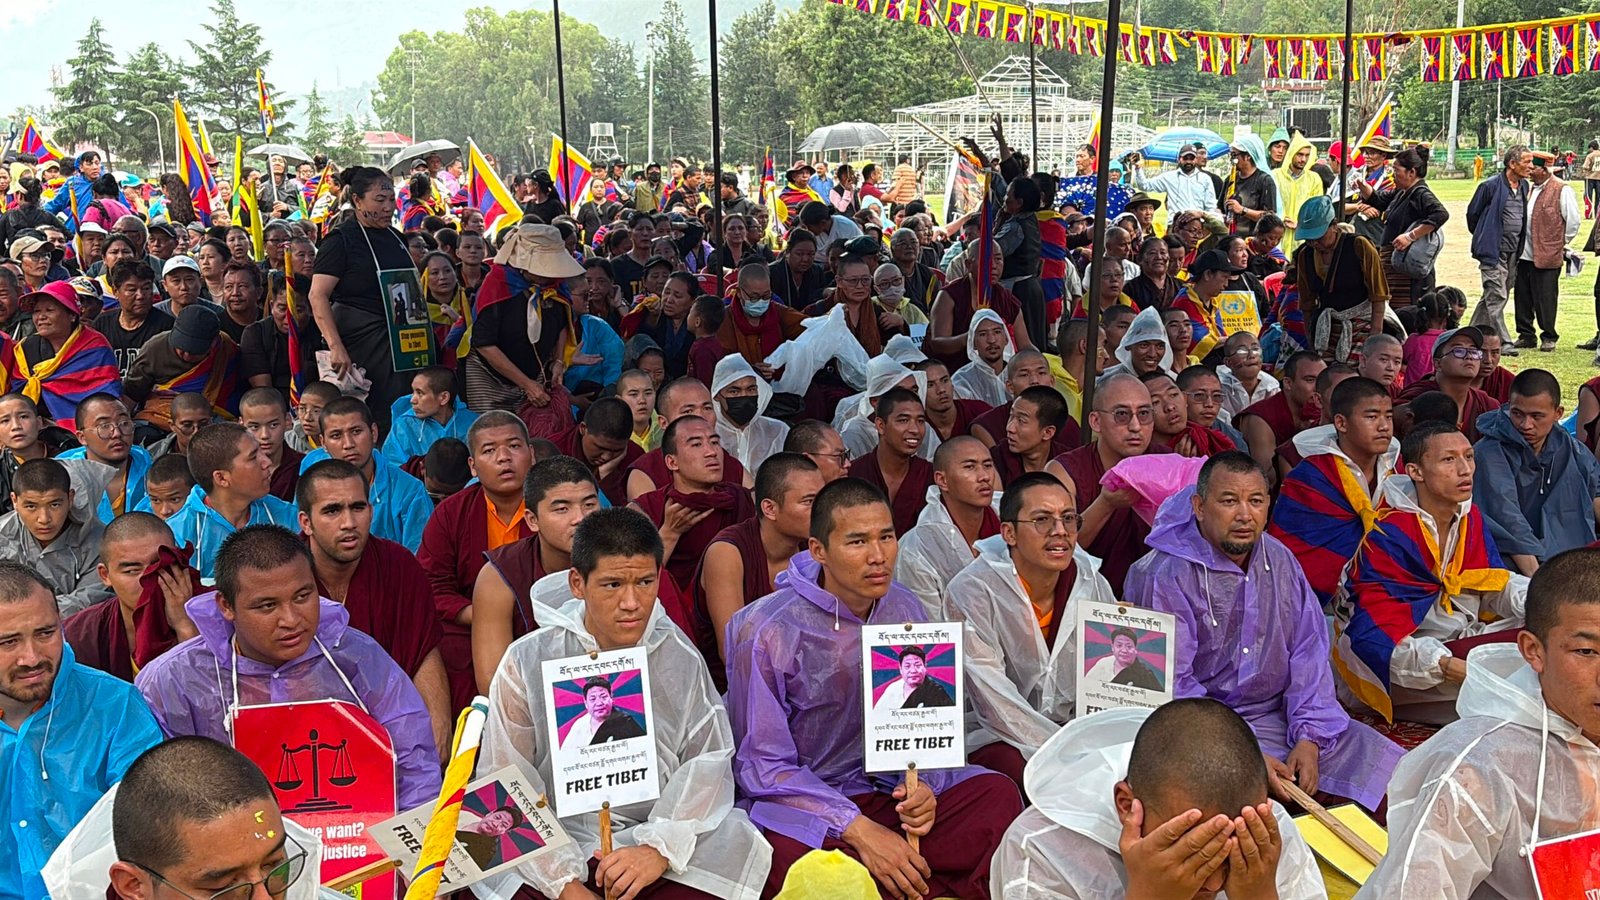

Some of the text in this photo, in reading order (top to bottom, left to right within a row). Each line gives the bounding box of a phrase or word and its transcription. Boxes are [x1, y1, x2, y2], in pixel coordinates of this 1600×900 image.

[875, 736, 954, 752] FREE TIBET
[566, 767, 648, 795] FREE TIBET
[326, 821, 365, 839] want?
[393, 824, 422, 854] FREE
[323, 844, 367, 861] justice
